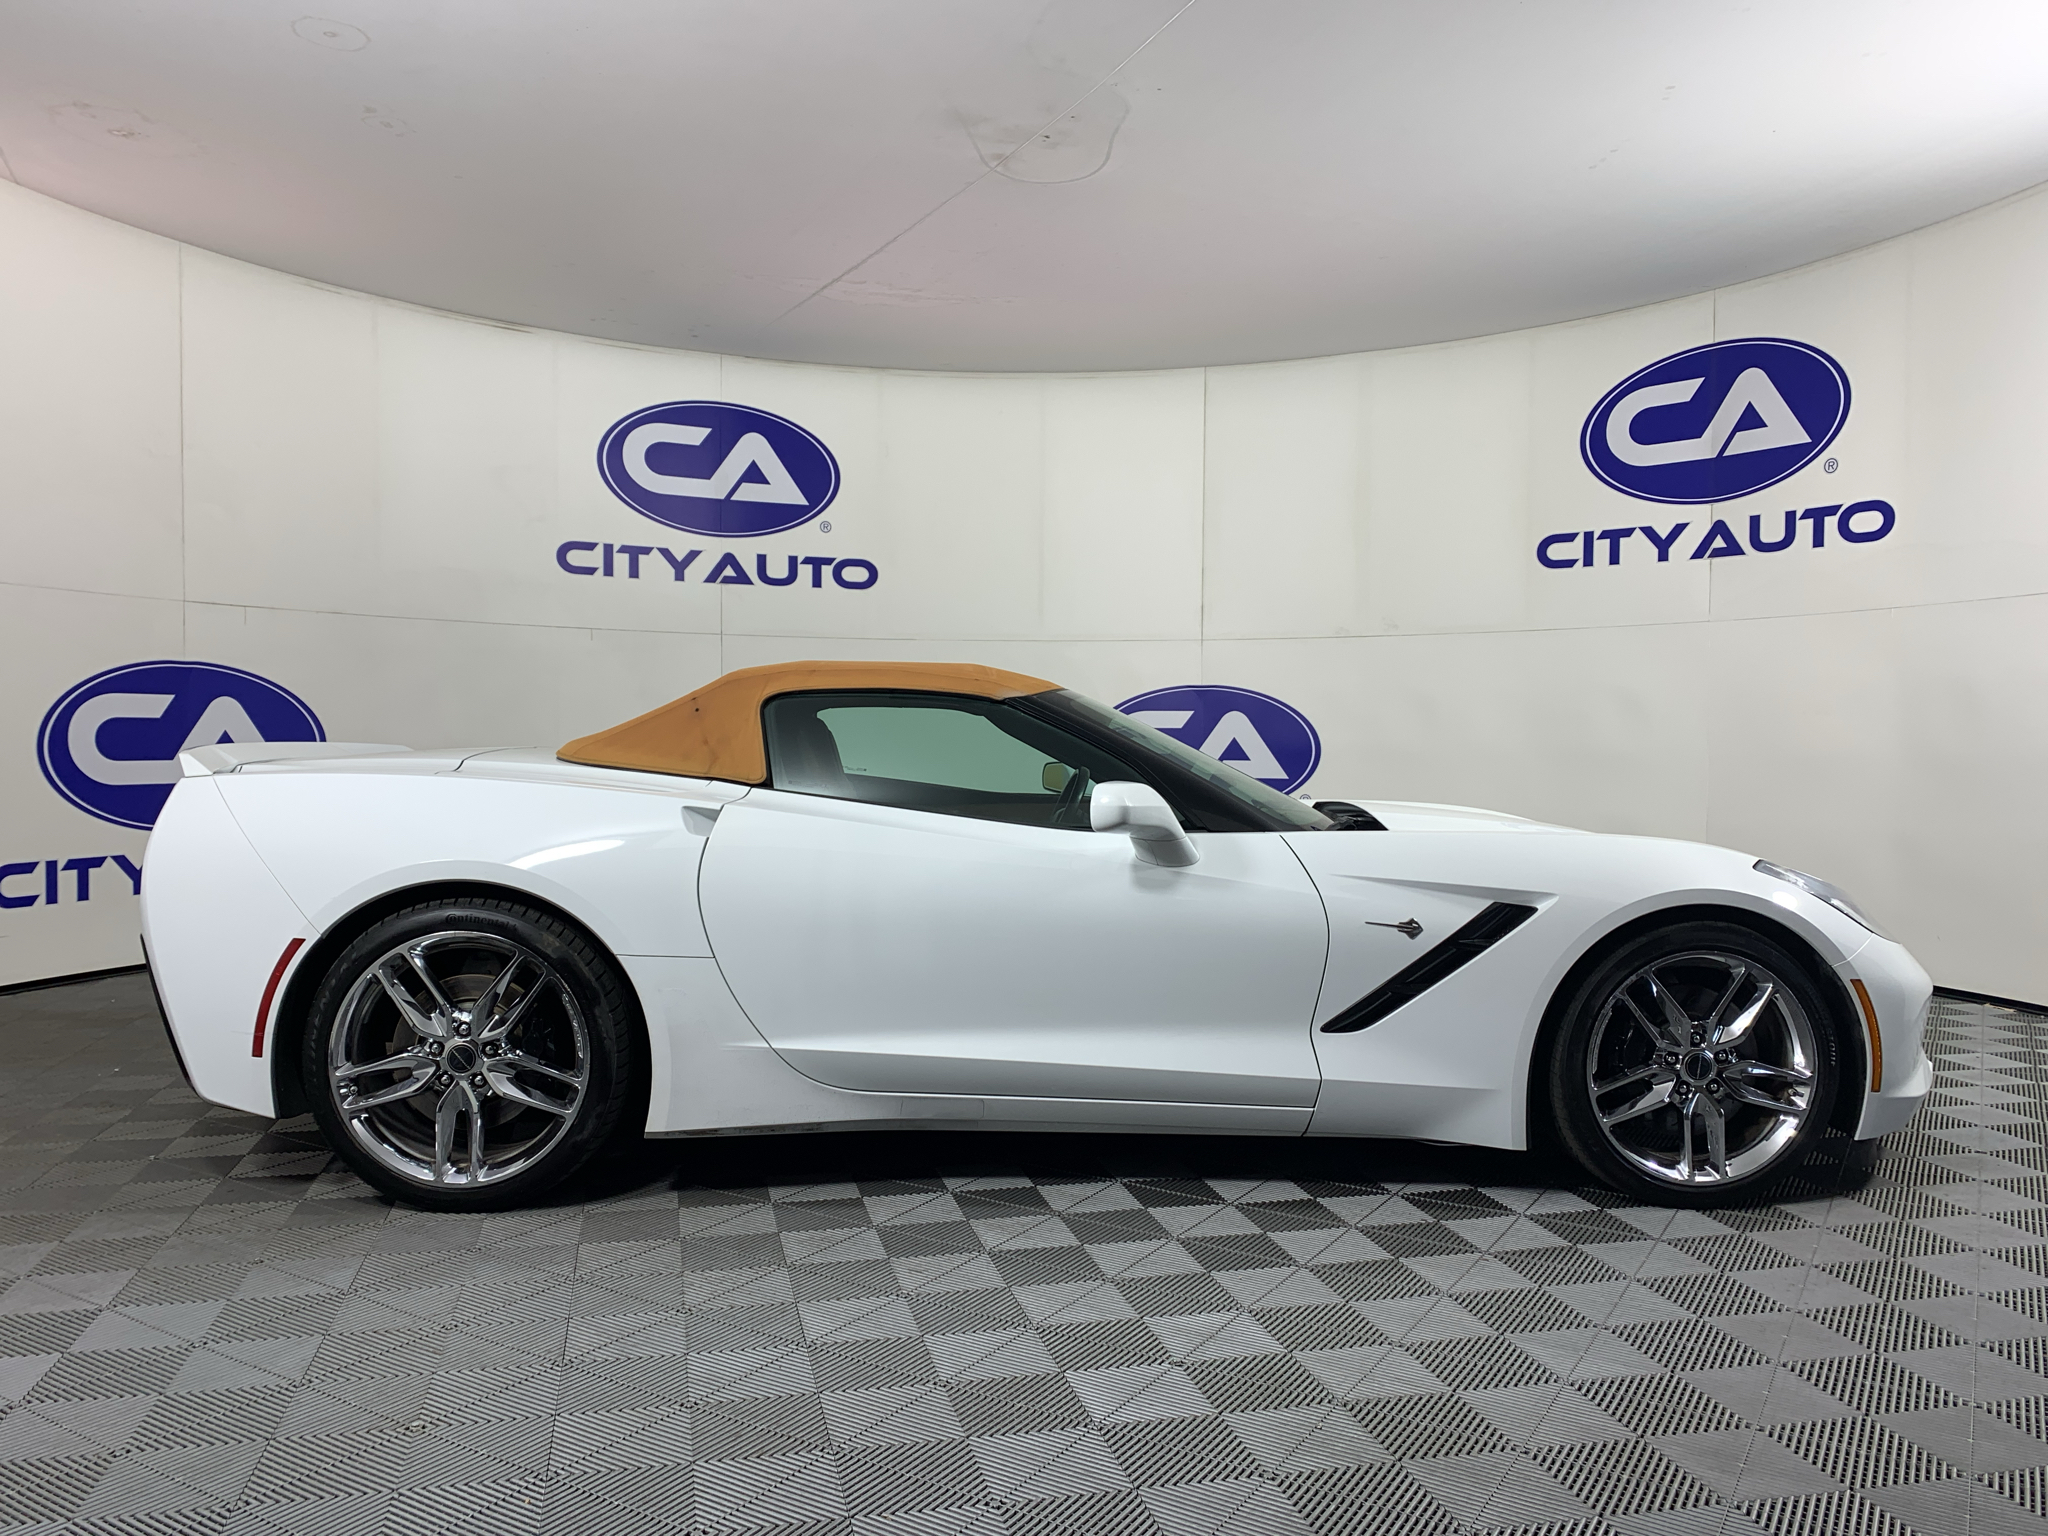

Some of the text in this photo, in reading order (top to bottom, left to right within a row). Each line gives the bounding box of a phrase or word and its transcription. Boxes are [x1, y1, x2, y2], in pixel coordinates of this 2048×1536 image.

[1606, 366, 1813, 467] CA
[622, 422, 810, 506] CA
[445, 913, 510, 929] Continental
